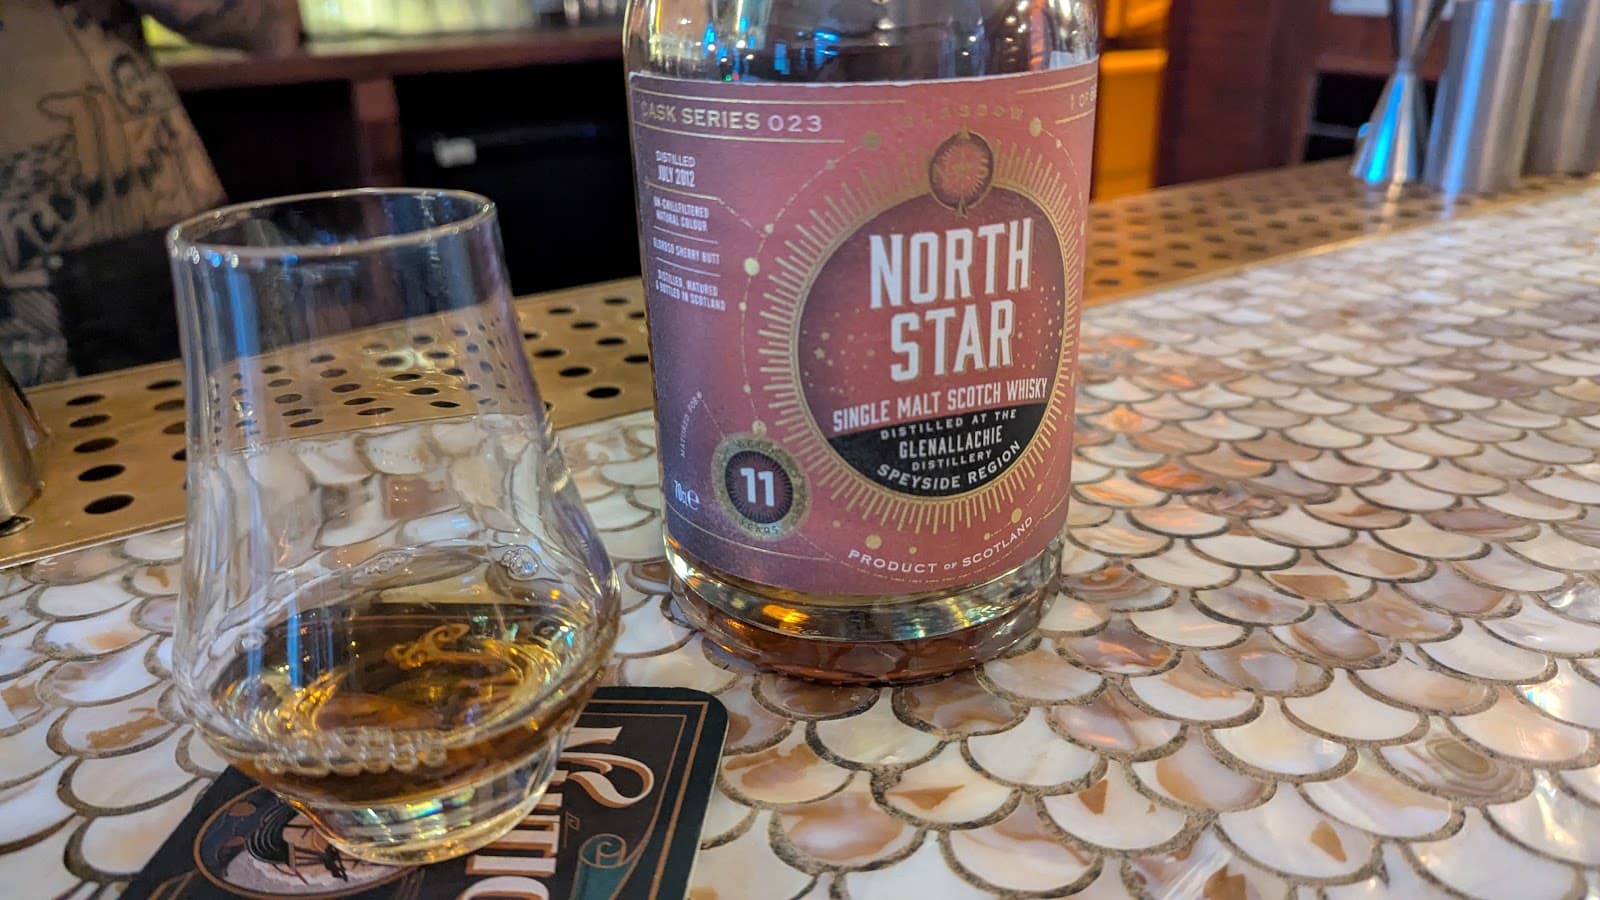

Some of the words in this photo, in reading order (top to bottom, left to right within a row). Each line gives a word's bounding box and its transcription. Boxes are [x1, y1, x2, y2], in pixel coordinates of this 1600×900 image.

[640, 100, 676, 123] CASK
[681, 107, 760, 130] SERIES
[767, 114, 822, 132] 023
[655, 150, 695, 168] DISTILLED
[658, 164, 674, 183] JULY
[675, 168, 695, 188] 2012
[656, 209, 680, 226] NATURAL
[680, 216, 707, 231] COLOUR
[675, 245, 700, 261] SHERRY
[701, 251, 720, 265] BUTT
[869, 217, 1032, 309] NORTH
[659, 282, 681, 300] BOTTLED
[681, 290, 689, 303] IN
[689, 293, 726, 312] SCOTLAND
[686, 279, 719, 297] MATURED
[890, 298, 1014, 382] STAR
[832, 400, 891, 433] SINGLE
[897, 391, 941, 419] MALT
[947, 382, 1001, 410] SCOTCH
[1006, 377, 1048, 401] WHISKY
[880, 416, 963, 440] DISTILLED
[971, 413, 988, 425] AT
[994, 409, 1017, 422] THE
[898, 425, 1003, 459] GLENALLACHIE
[876, 463, 961, 490] SPEYSIDE
[967, 440, 1021, 485] REGION
[911, 449, 992, 471] DISTILLERY
[740, 467, 775, 508] 11
[848, 549, 938, 574] PRODUCT
[962, 516, 1033, 567] SCOTLAND
